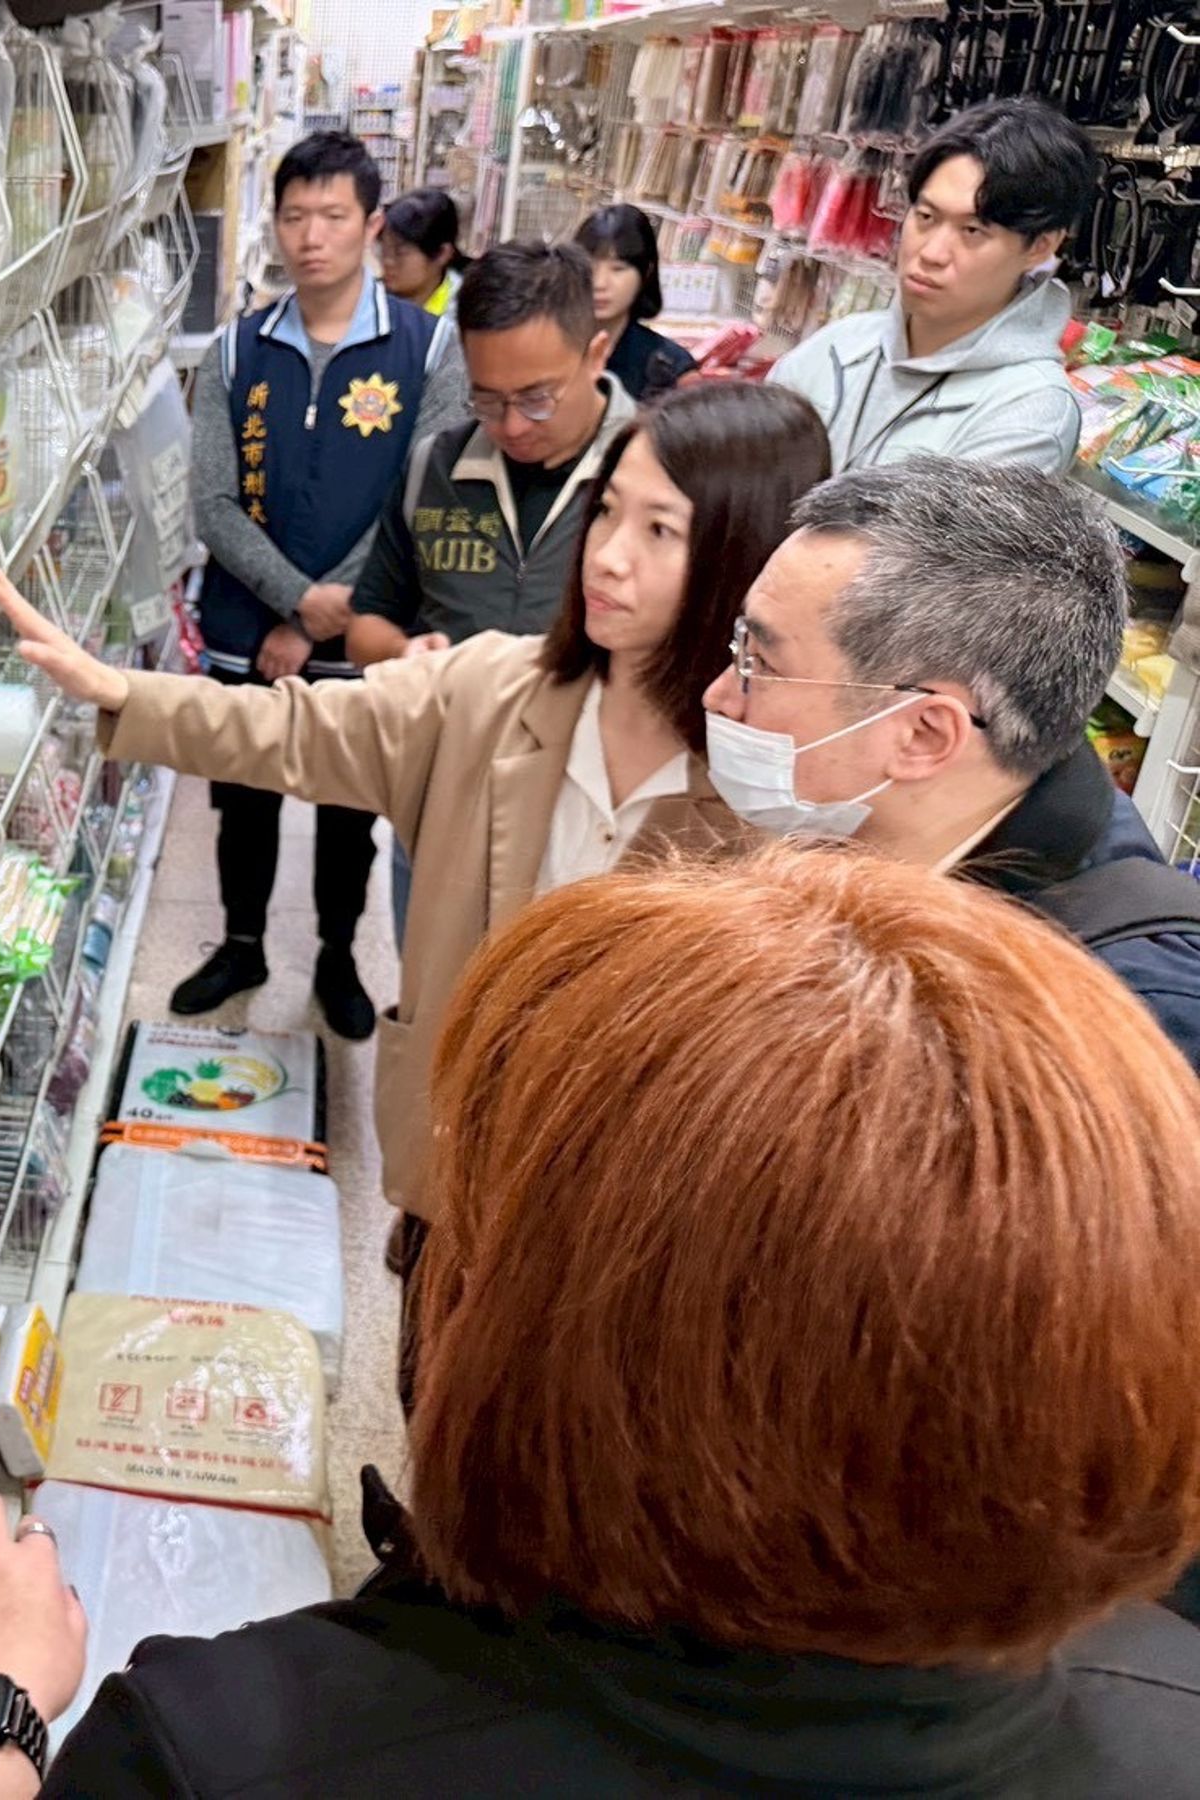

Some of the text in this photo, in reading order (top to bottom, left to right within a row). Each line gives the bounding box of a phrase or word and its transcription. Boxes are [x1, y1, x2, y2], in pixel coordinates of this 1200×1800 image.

[417, 538, 497, 573] MJIB
[125, 1462, 164, 1478] MADE
[184, 1468, 238, 1484] TAIWAN
